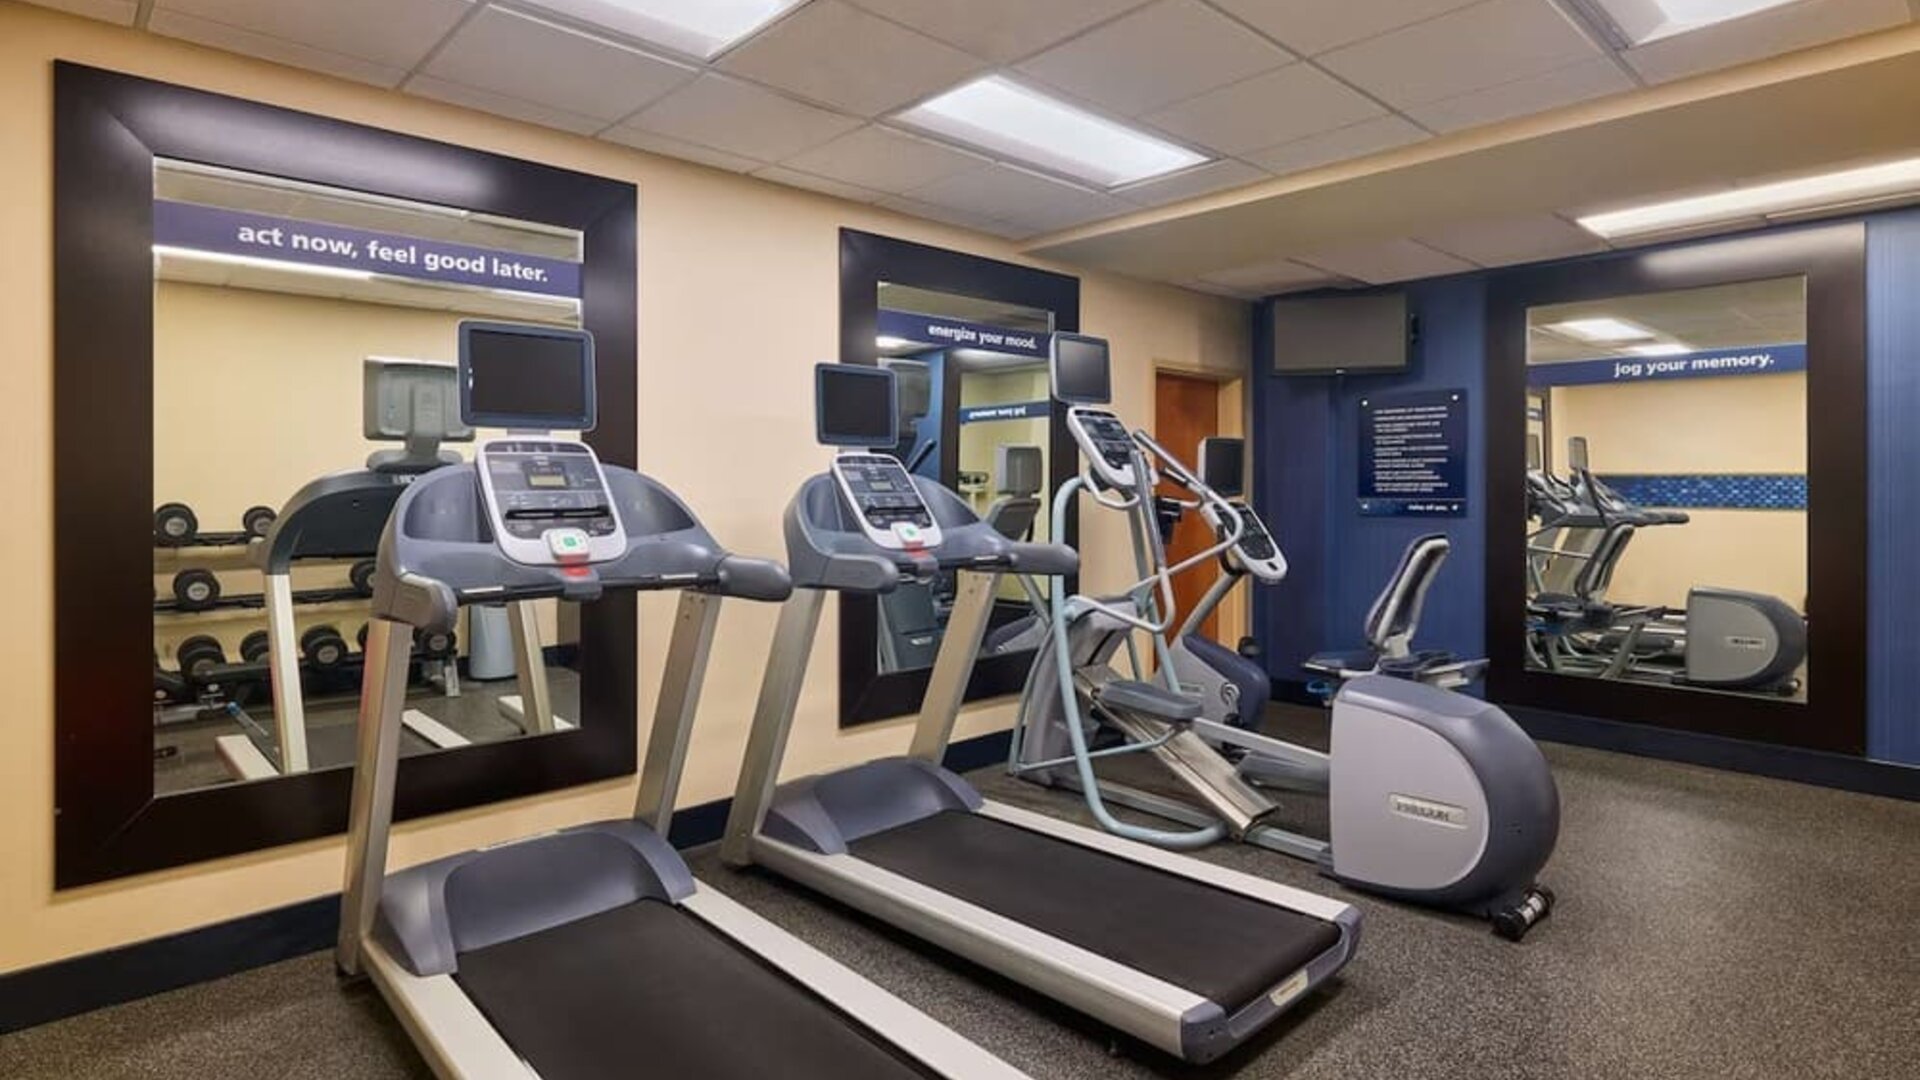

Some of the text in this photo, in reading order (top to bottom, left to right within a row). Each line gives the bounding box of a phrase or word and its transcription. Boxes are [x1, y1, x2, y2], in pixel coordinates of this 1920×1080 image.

[238, 224, 549, 283] act now, feel good later.
[927, 323, 1038, 350] energize your mood.
[1614, 353, 1775, 378] jog your memory.
